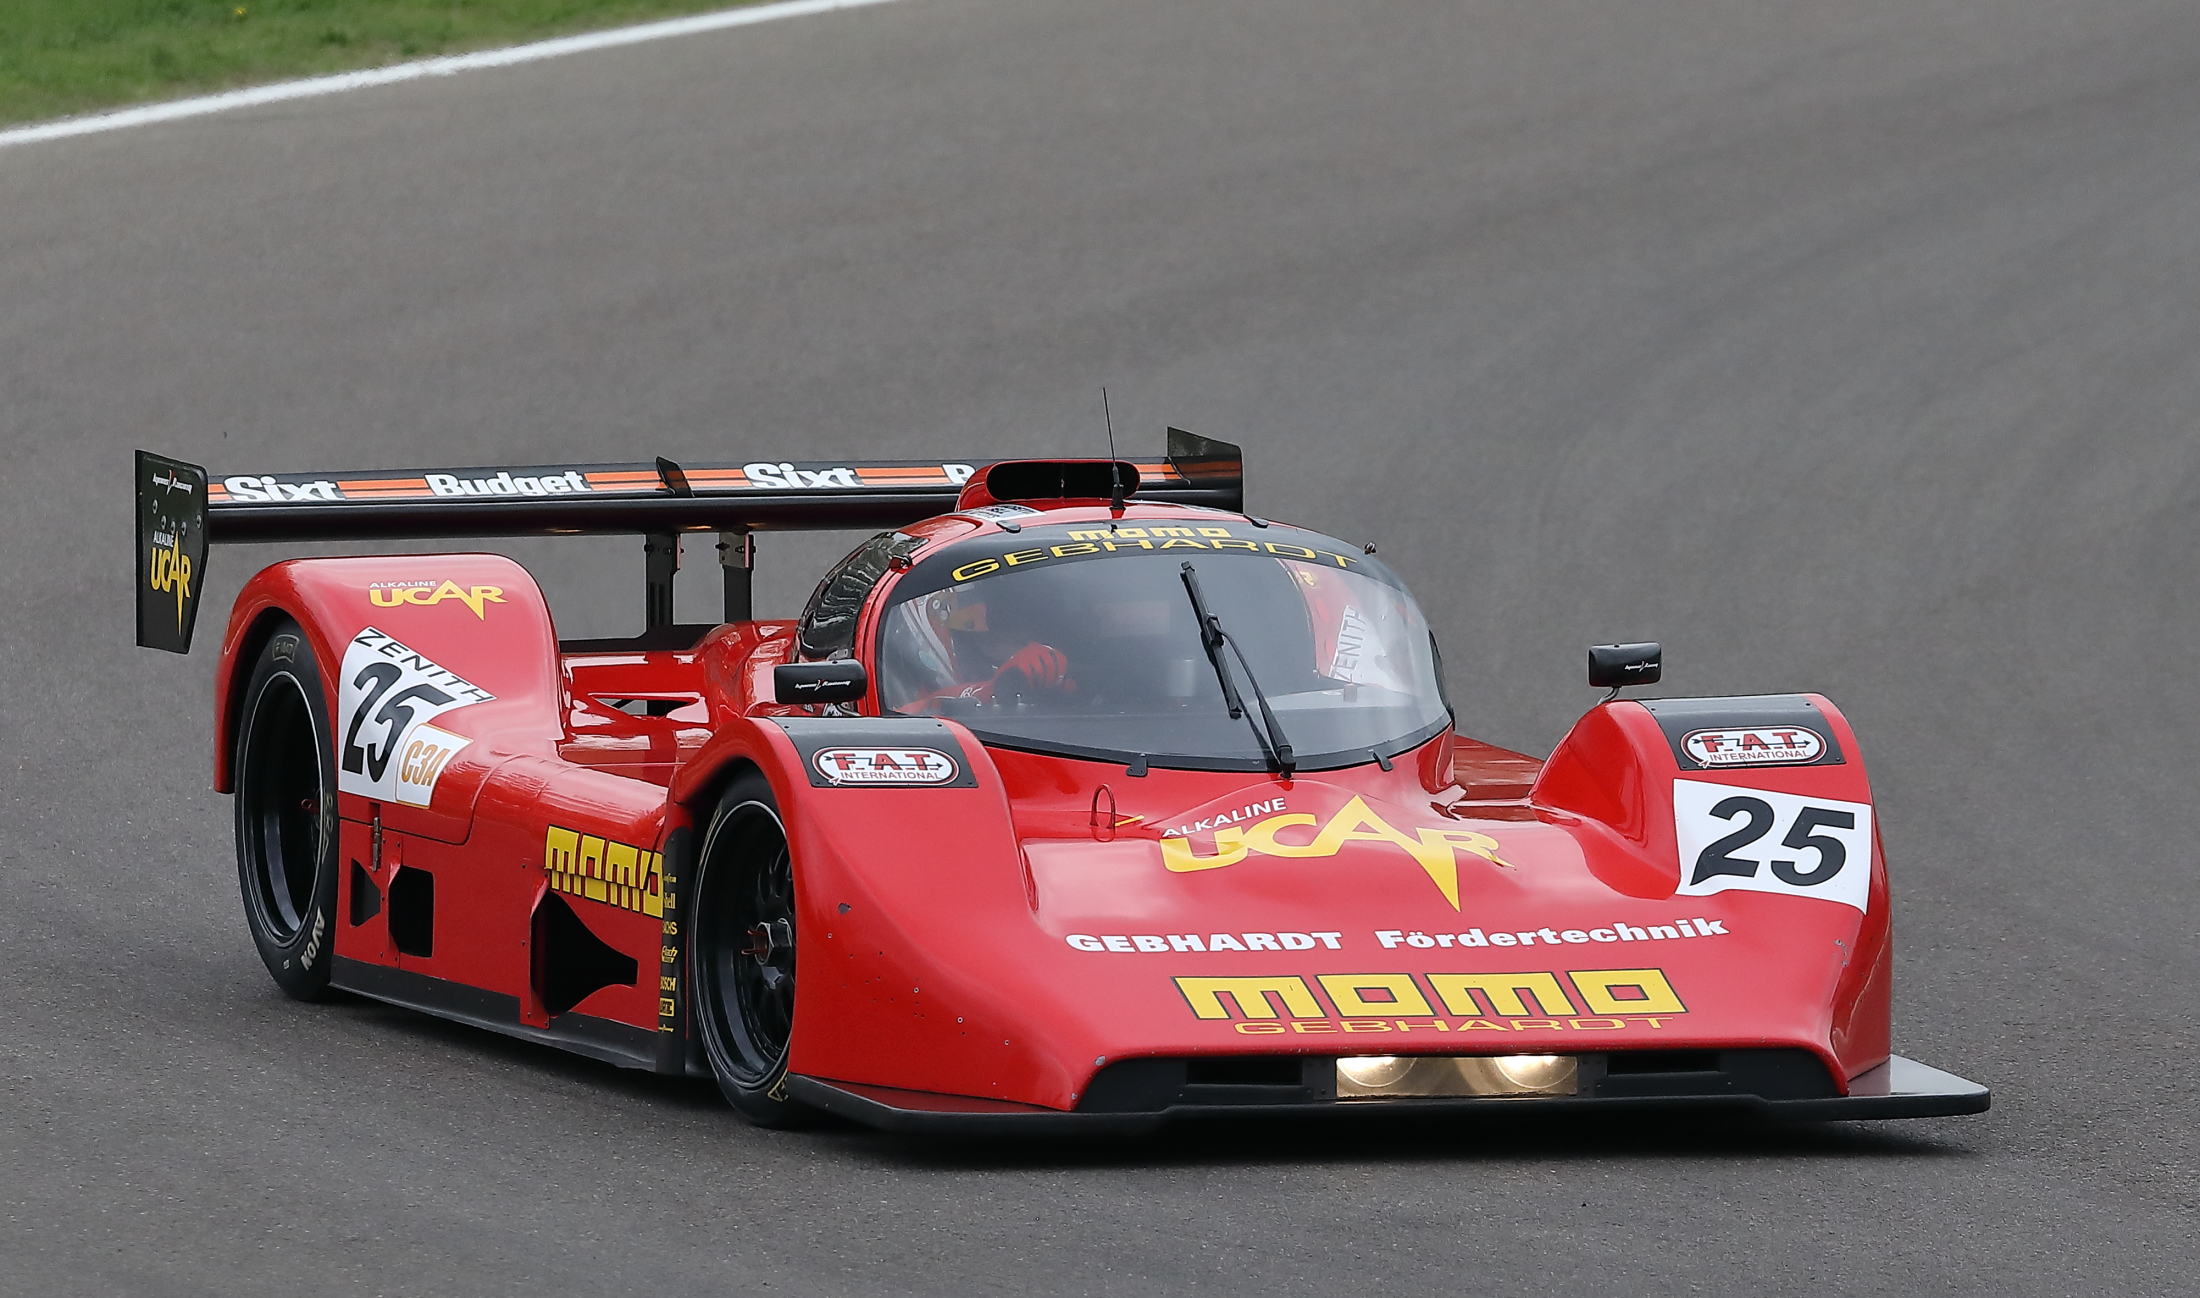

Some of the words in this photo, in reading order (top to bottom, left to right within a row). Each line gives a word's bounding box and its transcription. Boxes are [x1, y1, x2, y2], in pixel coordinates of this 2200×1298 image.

[224, 475, 346, 501] Sixt
[424, 471, 592, 496] Budget
[742, 462, 865, 488] Sixt
[153, 530, 174, 548] ALKALINE
[951, 538, 1357, 582] GEBHARDT
[151, 531, 192, 635] UCAR
[369, 580, 437, 588] ALKALINE
[369, 579, 508, 621] UCAR
[354, 628, 496, 703] ZENITH
[342, 661, 458, 783] 25
[402, 739, 452, 787] C3A
[840, 771, 943, 781] INTERNATIONAL
[1708, 750, 1812, 763] INTERNATIONAL
[1162, 797, 1288, 838] ALKALINE
[1158, 795, 1516, 913] UCAR
[1690, 795, 1855, 887] 25
[300, 905, 325, 971] AVON
[1066, 931, 1342, 954] GEBHARDT
[1377, 917, 1731, 950] Fördertechnik
[1234, 1016, 1675, 1035] GEBHARDT
